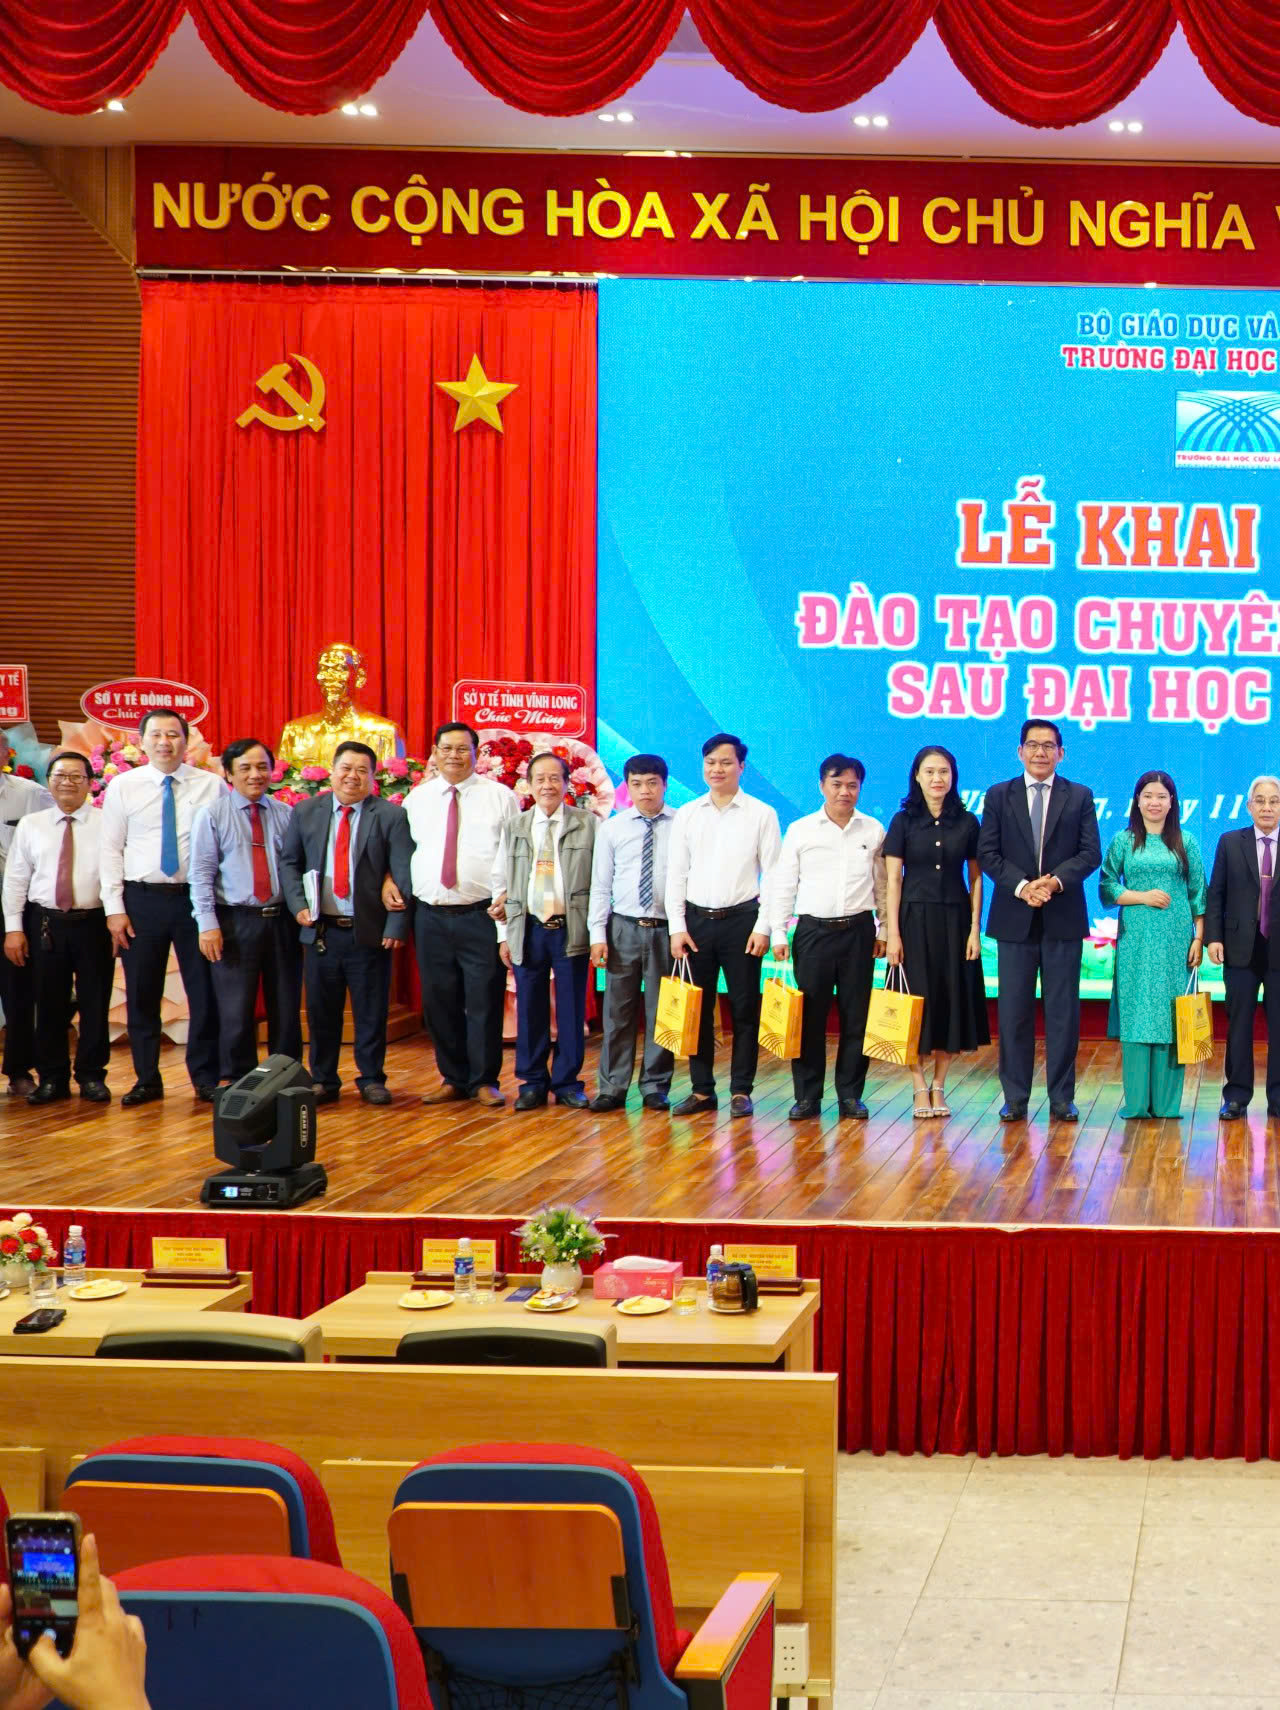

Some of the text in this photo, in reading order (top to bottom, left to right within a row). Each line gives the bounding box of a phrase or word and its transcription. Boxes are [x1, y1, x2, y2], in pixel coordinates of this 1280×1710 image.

[153, 172, 331, 231] NƯỚC
[351, 174, 525, 246] CỘNG
[546, 178, 675, 240] HÒA
[690, 184, 779, 241] XÃ
[799, 189, 899, 256] HỘI
[922, 185, 1045, 247] CHỦ
[1069, 191, 1256, 250] NGHĨA
[1078, 309, 1112, 341] BỘ
[1120, 309, 1179, 337] GIÁO
[1187, 316, 1239, 342] DỤC
[1246, 312, 1279, 339] VÀ
[1061, 341, 1165, 370] TRƯỜNG
[1173, 348, 1218, 376] ĐẠI
[1226, 350, 1277, 376] HỌC
[961, 480, 1051, 566] LỄ
[1080, 502, 1256, 569] KHAI
[798, 590, 917, 647] ĐÀO
[938, 599, 1053, 659] TẠO
[94, 690, 111, 705] SỞ
[113, 692, 121, 705] Y
[123, 690, 138, 706] TẾ
[174, 694, 195, 707] NAI
[463, 687, 578, 710] SỞ Y TẾ TỈNH VĨNH LONG
[474, 707, 513, 723] Chúc
[890, 665, 1006, 717] SAU
[1027, 669, 1129, 732] ĐẠI
[1151, 671, 1268, 731] HỌC
